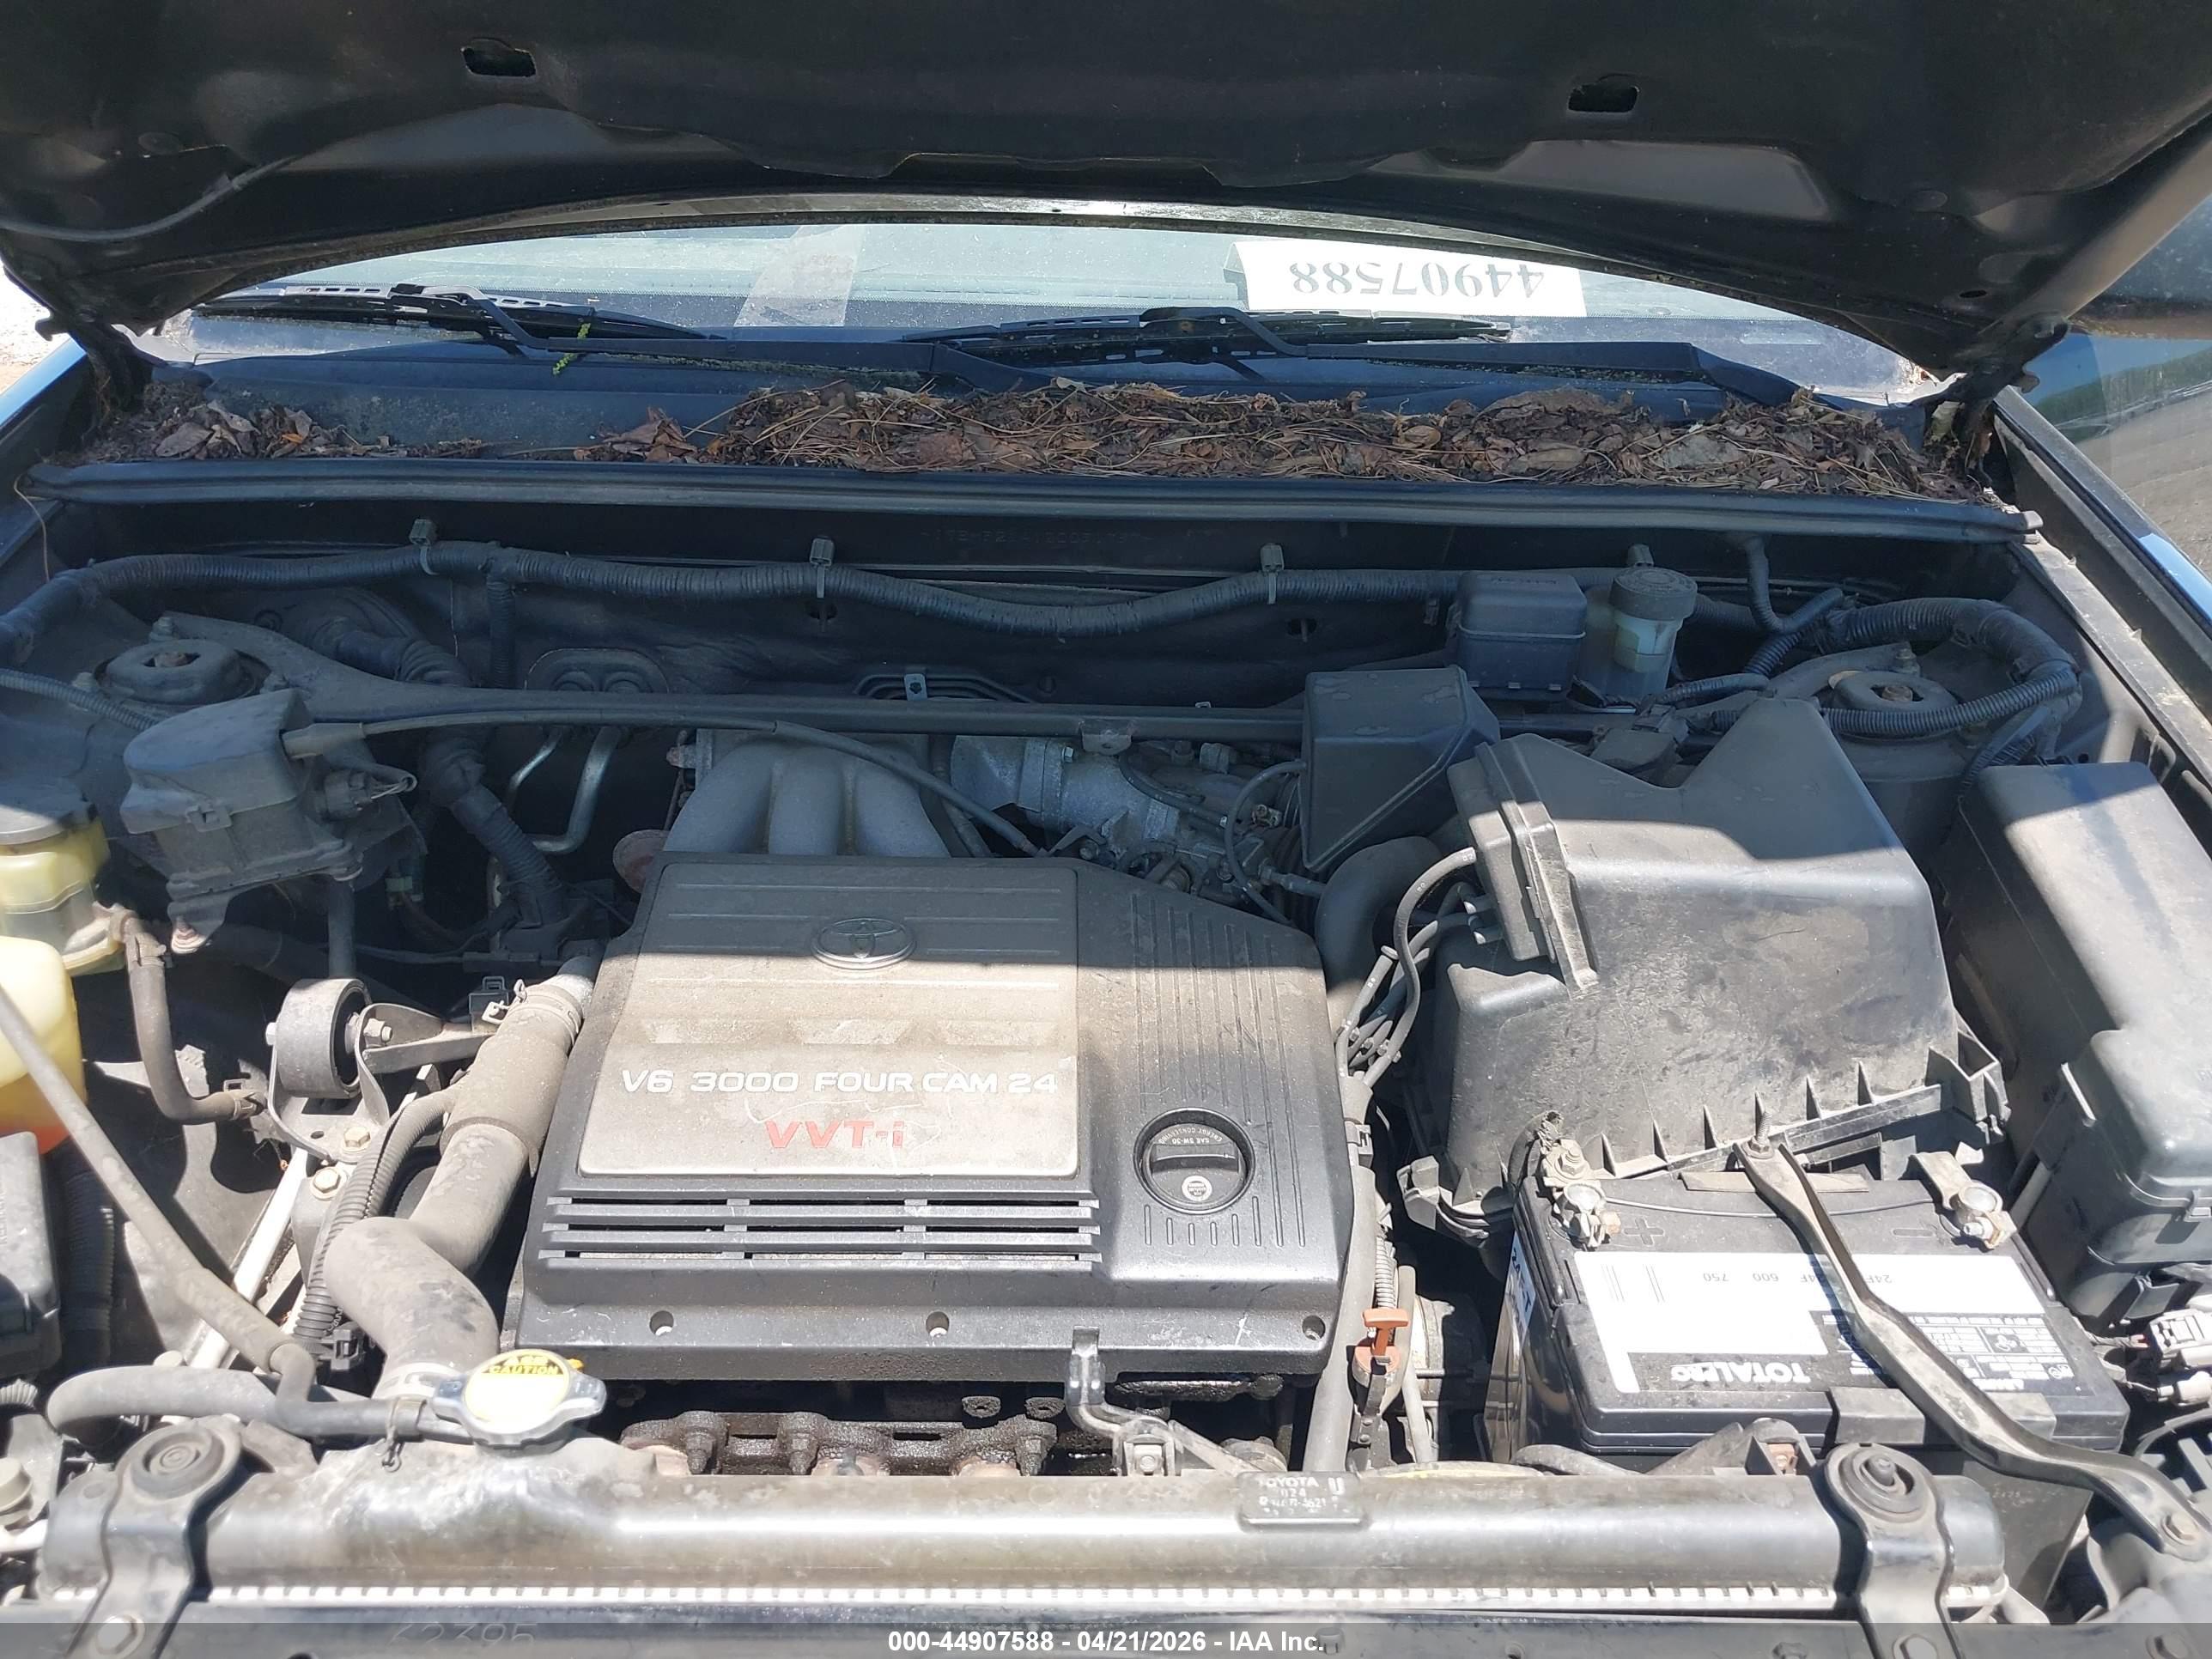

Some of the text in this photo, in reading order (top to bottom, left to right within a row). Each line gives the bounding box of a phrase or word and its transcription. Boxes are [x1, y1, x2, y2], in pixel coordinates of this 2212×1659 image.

[1289, 261, 1545, 299] 44907588
[622, 1070, 1059, 1093] V6 3000 FOUR CAM 24
[765, 1121, 904, 1149] VVT-i
[1702, 1272, 1729, 1283] 750
[1752, 1272, 1779, 1283] 600
[489, 1365, 559, 1375] CAUTION
[1256, 1476, 1320, 1488] TOYOTA
